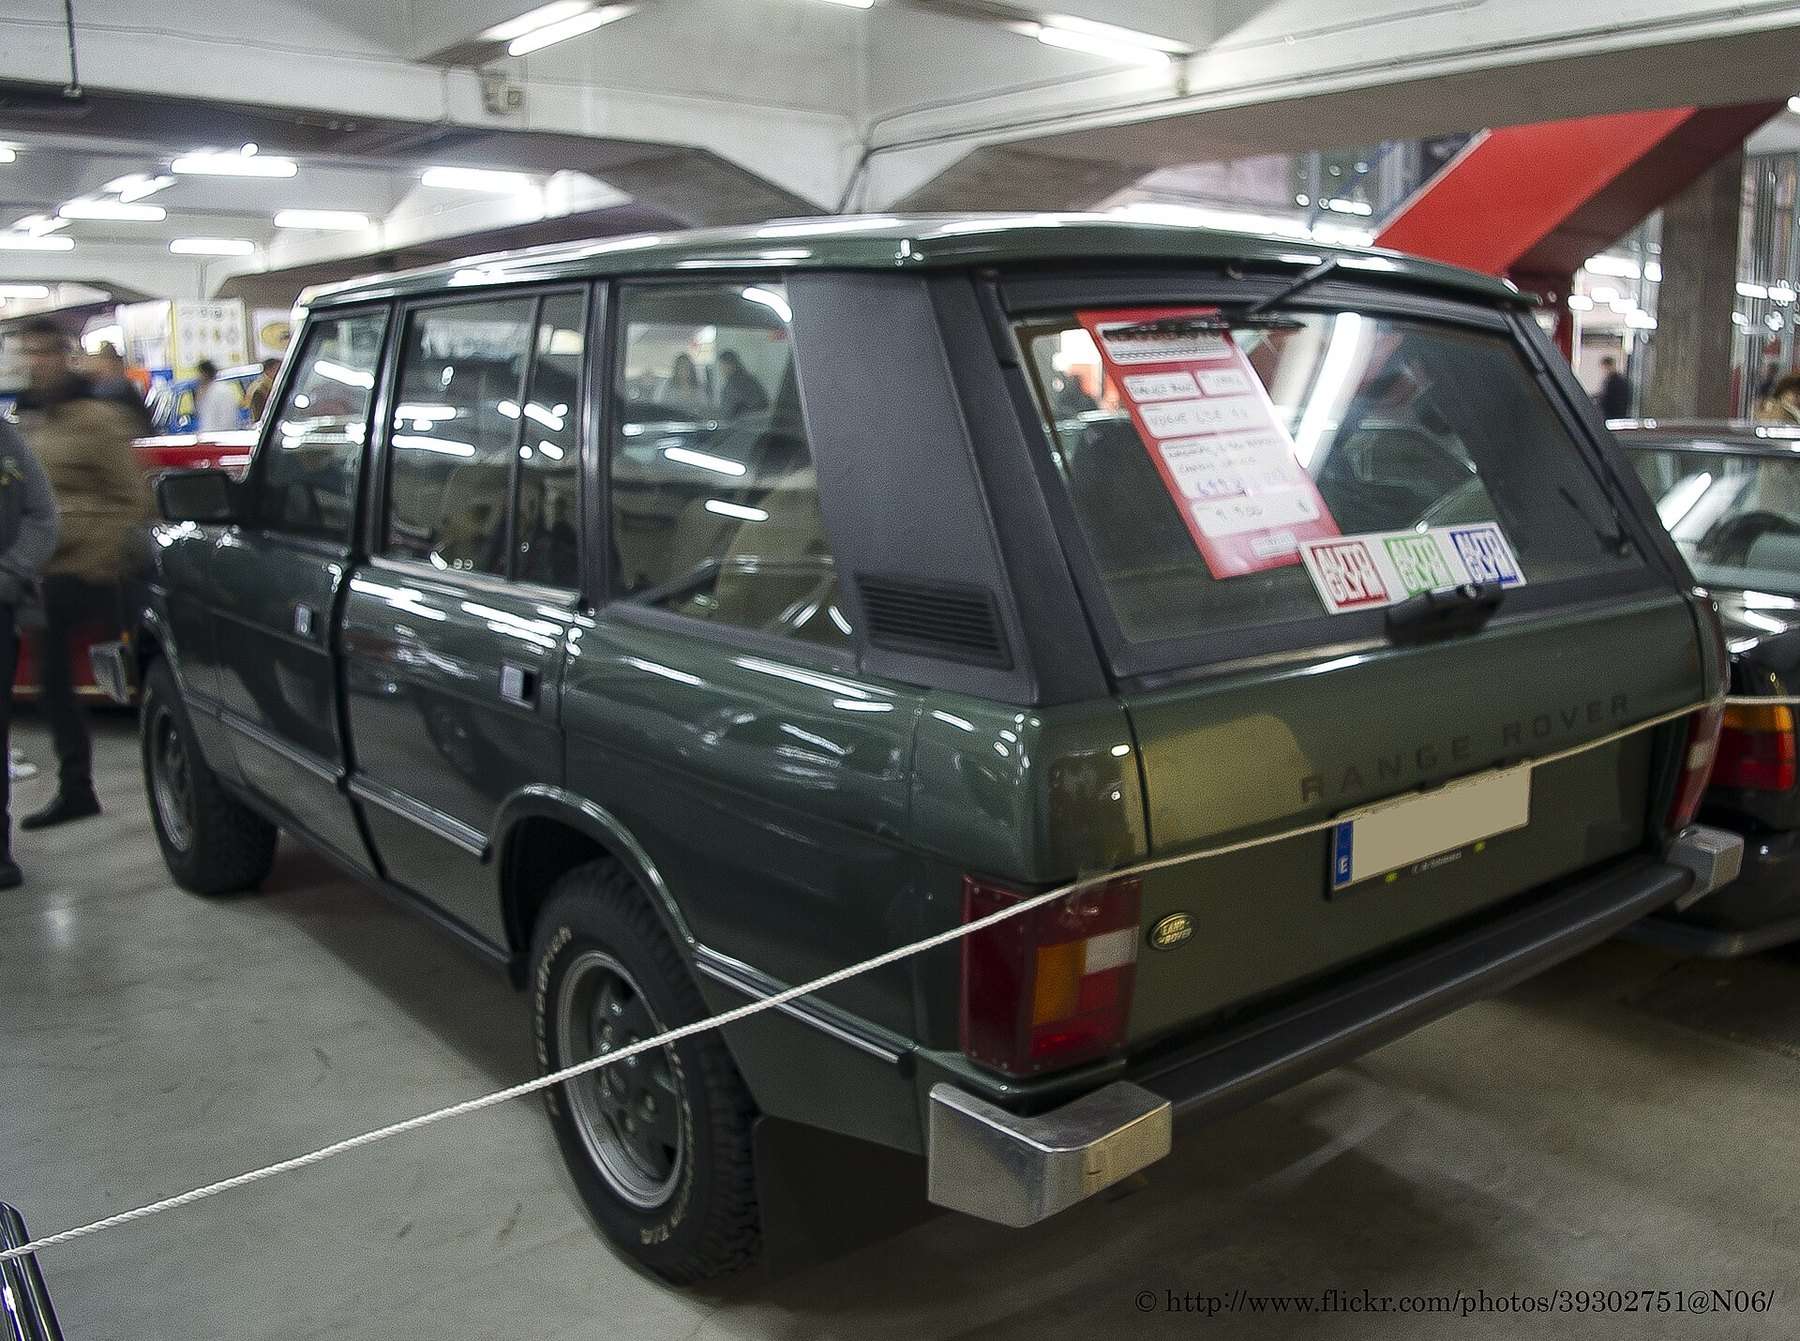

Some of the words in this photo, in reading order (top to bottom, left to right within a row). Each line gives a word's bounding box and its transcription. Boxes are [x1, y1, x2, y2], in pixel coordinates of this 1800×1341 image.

[1301, 736, 1470, 801] RANGE
[1502, 694, 1629, 746] ROVER
[1338, 856, 1349, 873] E
